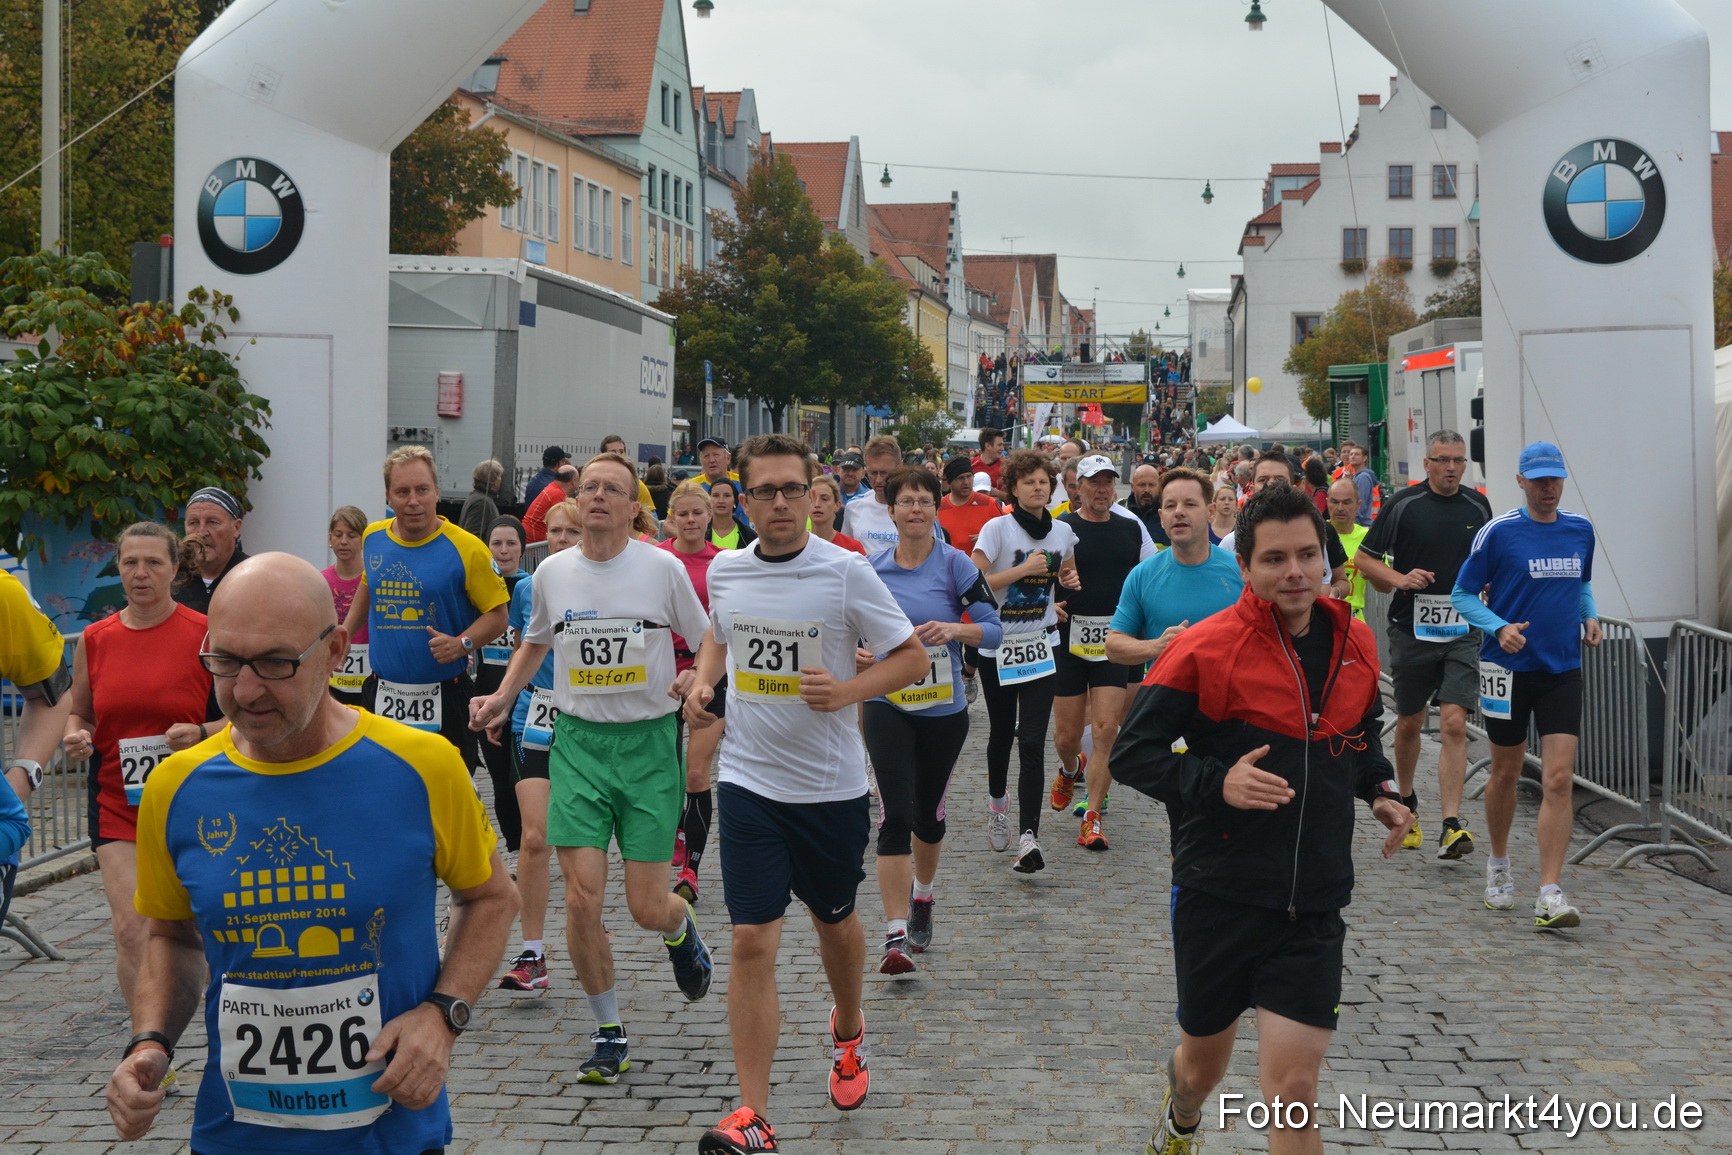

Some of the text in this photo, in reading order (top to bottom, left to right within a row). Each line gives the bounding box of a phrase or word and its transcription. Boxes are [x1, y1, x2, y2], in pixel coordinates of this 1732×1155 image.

[1553, 141, 1657, 184] BMW
[204, 160, 296, 199] BMW
[640, 355, 668, 398] BOCK
[1064, 389, 1106, 399] START
[1528, 558, 1582, 571] HUBER
[565, 625, 629, 635] PARTL Neumarkt
[733, 623, 805, 637] PARTL Neumarkt
[1425, 627, 1457, 635] Reinhard
[498, 650, 511, 659] Sel
[580, 637, 628, 666] 637
[748, 638, 799, 672] 231
[1002, 642, 1048, 666] 2568
[344, 655, 364, 674] 21
[1016, 666, 1037, 677] Karin
[336, 677, 363, 686] Claudia
[577, 669, 636, 686] Stefan
[1479, 674, 1506, 697] 915
[379, 685, 429, 697] PARTL Neumarkt
[758, 678, 789, 694] Björn
[533, 692, 553, 703] PARTL
[901, 691, 938, 703] Katarina
[382, 696, 435, 721] 2848
[142, 744, 169, 752] Neum
[211, 818, 222, 827] 15
[206, 830, 229, 840] Jahre
[226, 907, 347, 926] 21.September 2014
[223, 997, 351, 1018] PARTL Neumarkt
[236, 1015, 370, 1076] 2426
[268, 1088, 347, 1110] Norbert
